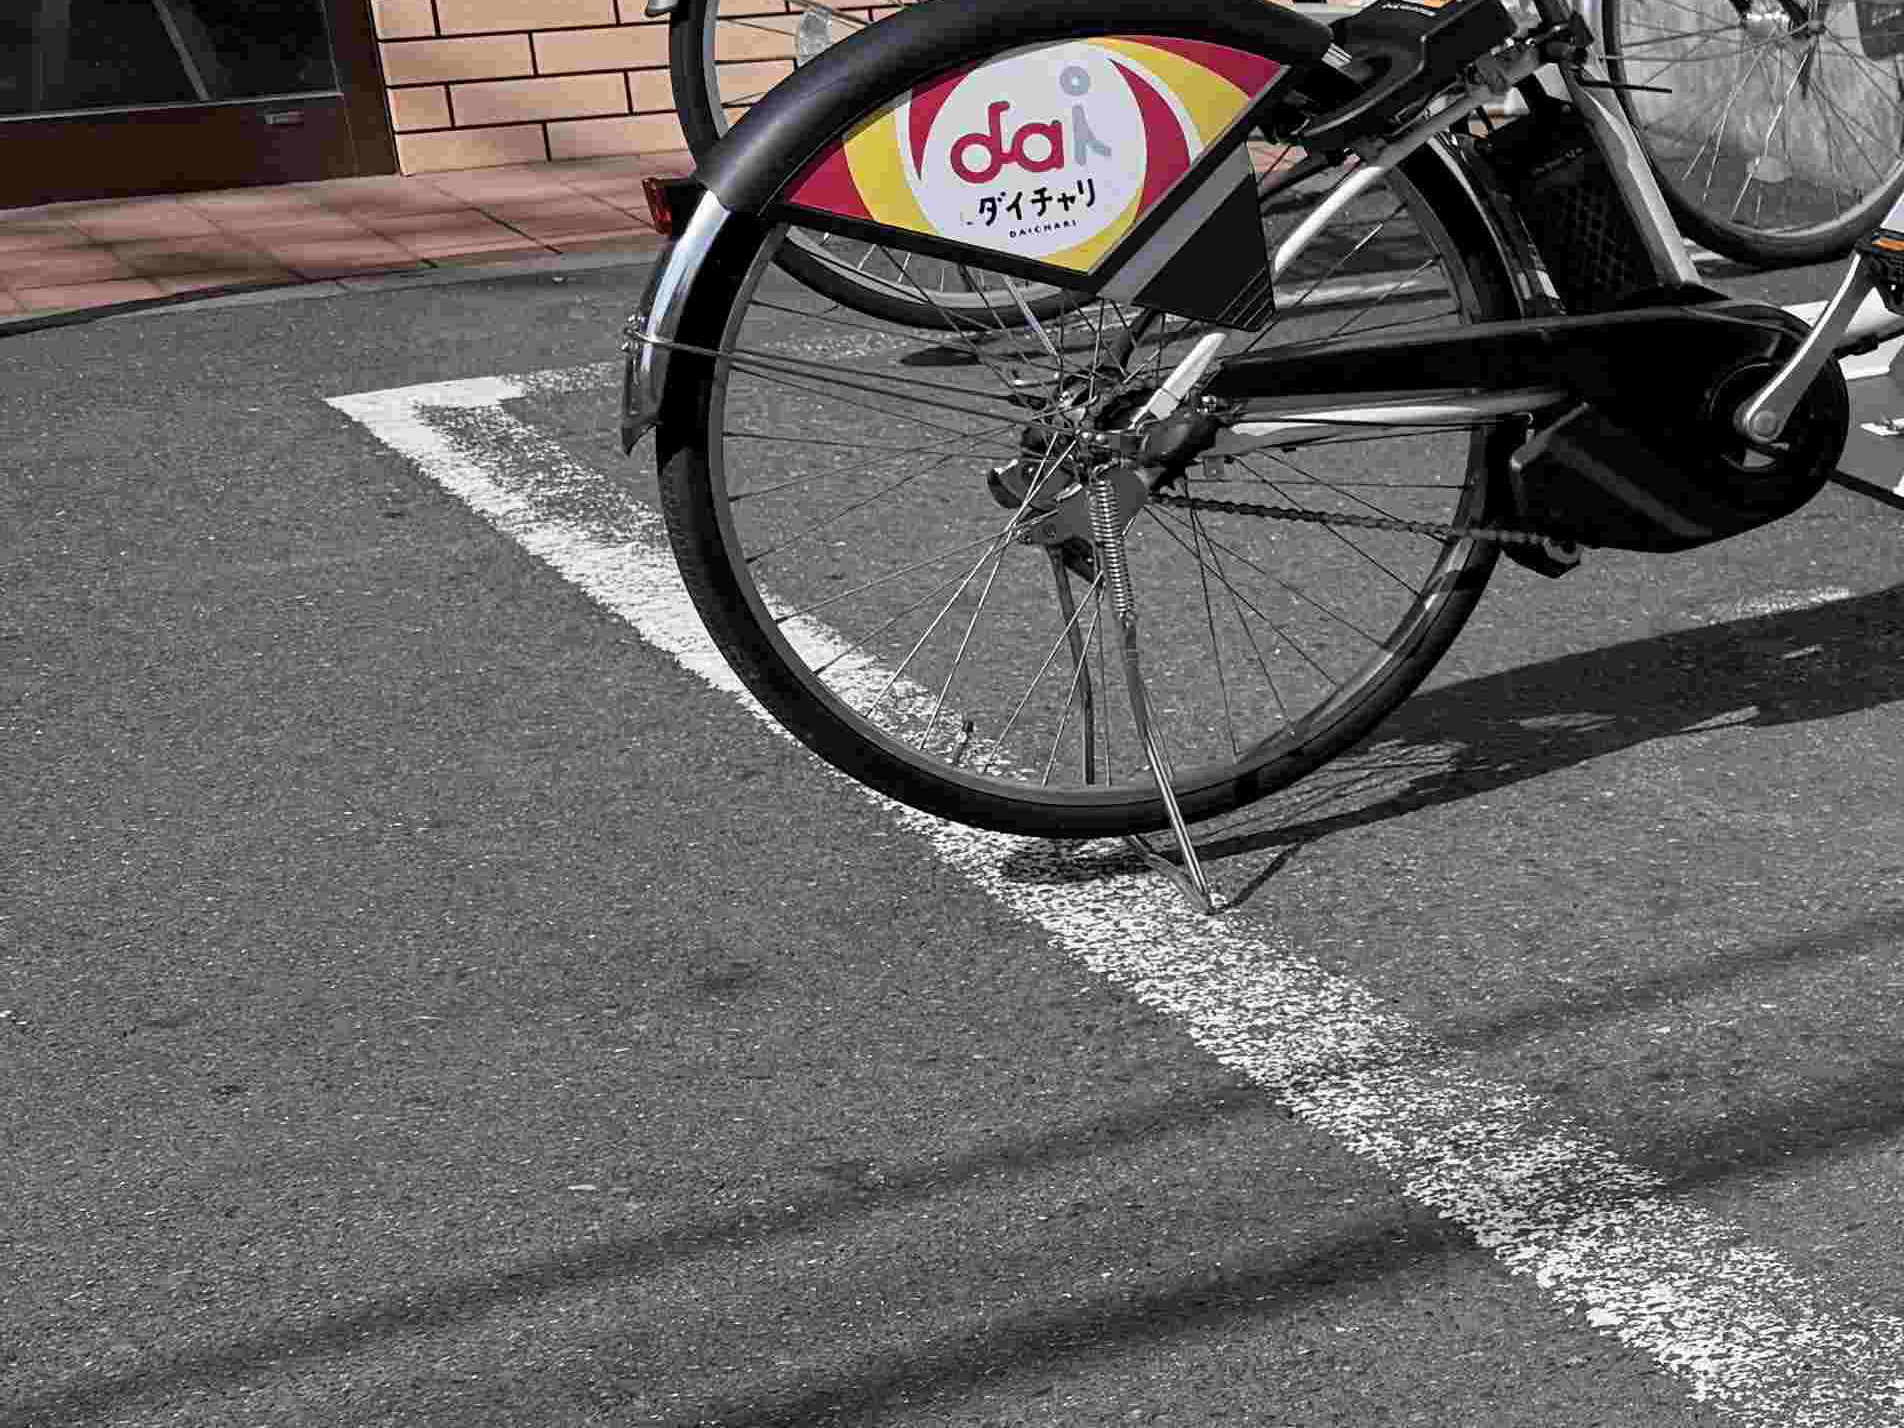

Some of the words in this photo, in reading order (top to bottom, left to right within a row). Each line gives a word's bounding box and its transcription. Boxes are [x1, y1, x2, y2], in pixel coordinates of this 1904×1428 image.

[950, 65, 1112, 184] dai
[977, 177, 1096, 228] ダイチャリ
[1008, 218, 1080, 239] DAICHARI
